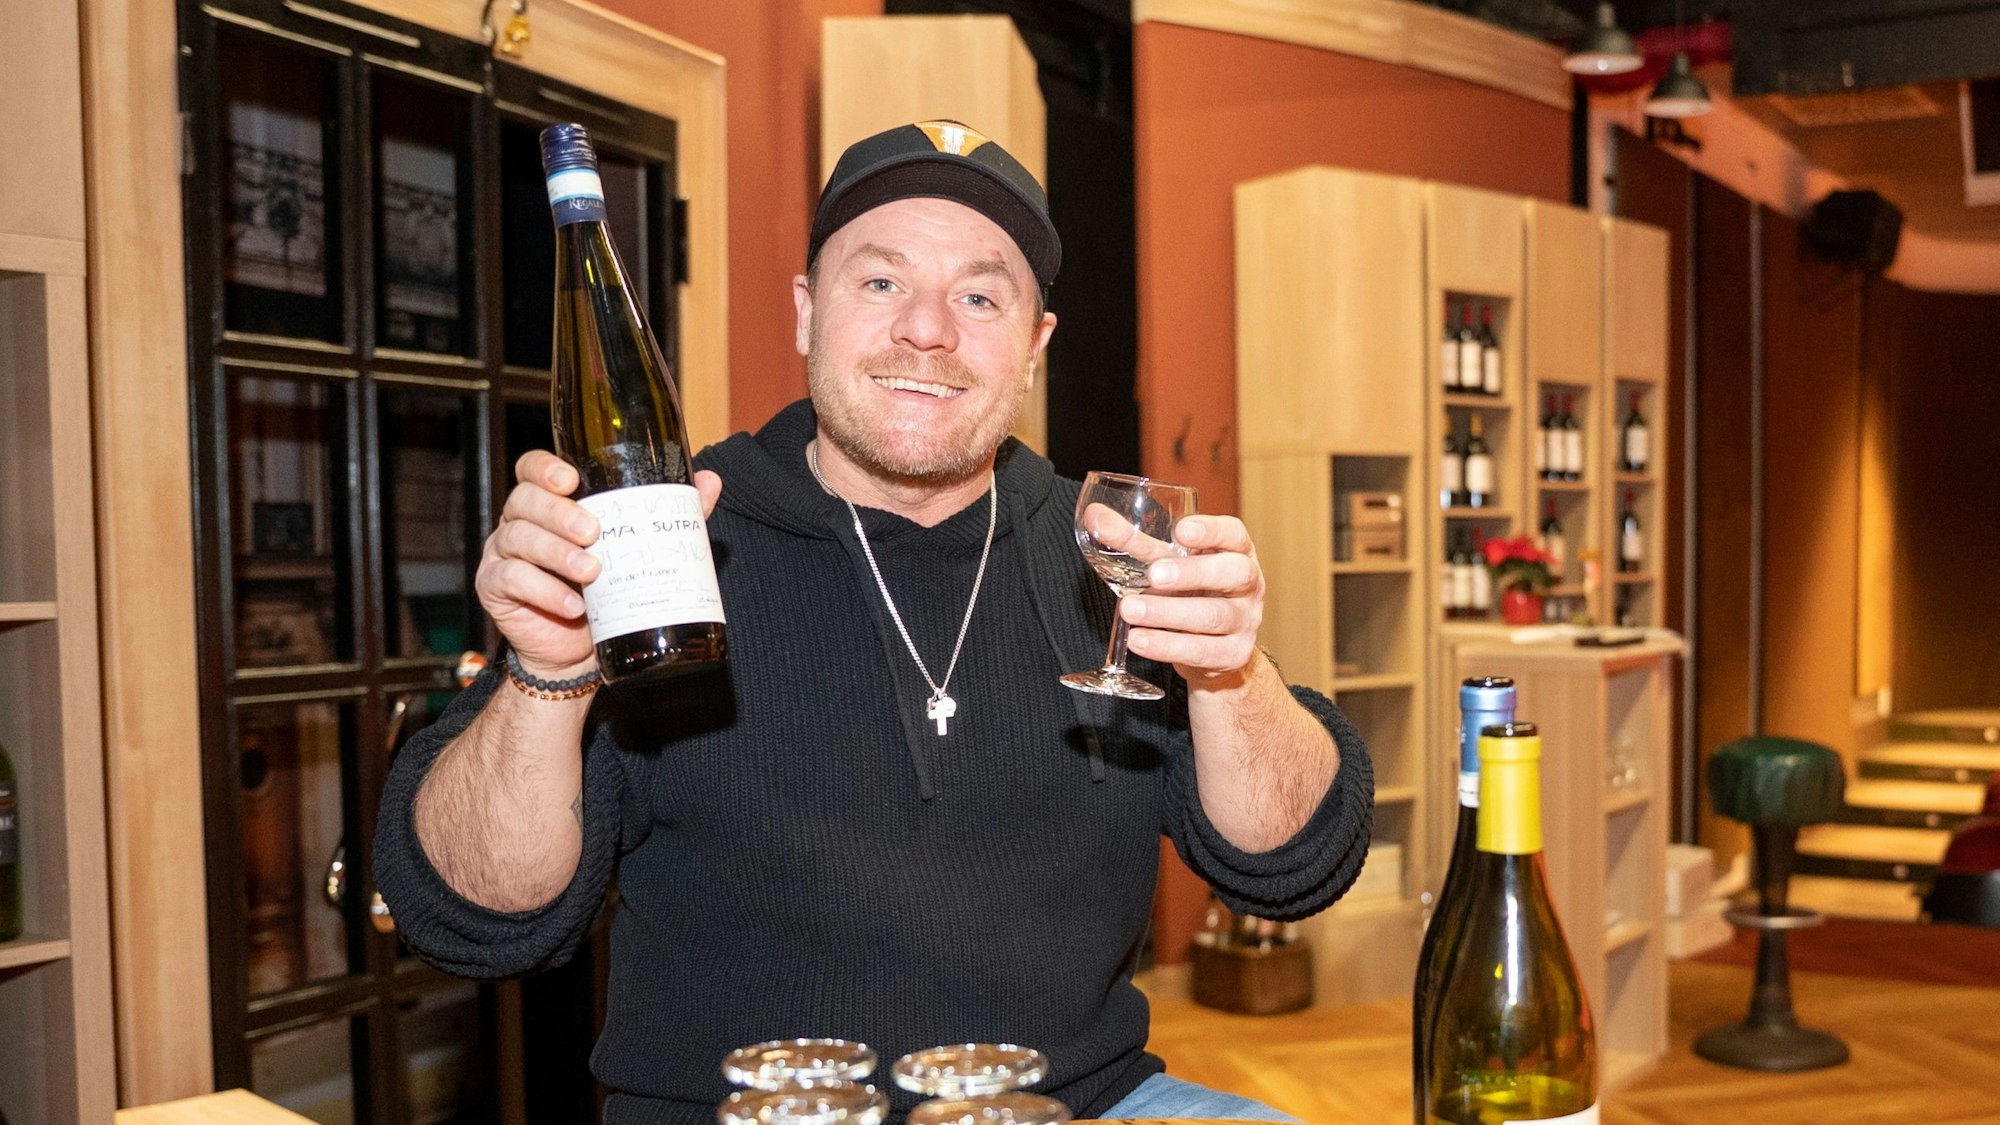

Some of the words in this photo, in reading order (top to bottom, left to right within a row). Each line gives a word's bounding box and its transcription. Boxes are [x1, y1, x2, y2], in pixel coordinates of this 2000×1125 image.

[597, 526, 636, 541] MA
[652, 520, 701, 533] SUTRA
[608, 575, 623, 586] Vin
